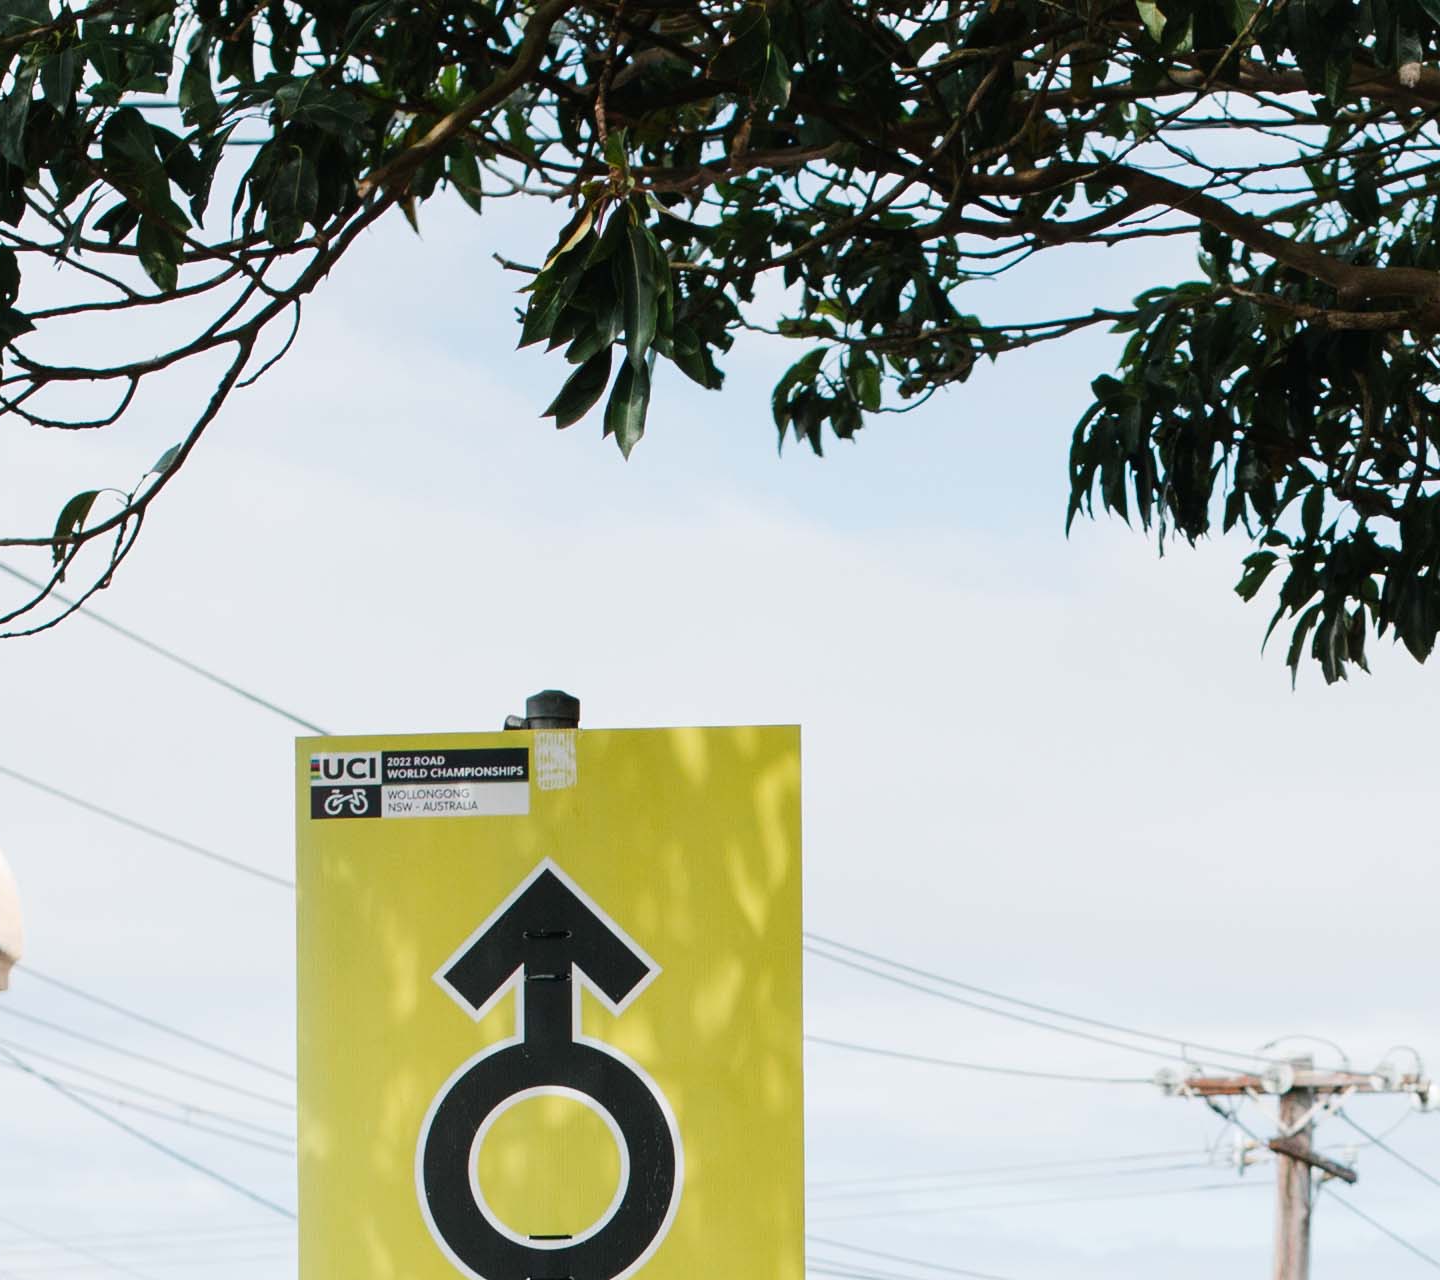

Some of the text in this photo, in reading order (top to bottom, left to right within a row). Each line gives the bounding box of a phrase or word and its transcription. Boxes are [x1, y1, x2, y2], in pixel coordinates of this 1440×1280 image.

[386, 755, 446, 767] 2022 ROAD
[322, 757, 377, 780] UCI
[386, 765, 525, 779] WORLD CHAMPIONSHIPS
[387, 788, 471, 800] WOLLONGONG
[388, 802, 412, 812] NSW
[422, 800, 479, 812] AUSTRALIA
